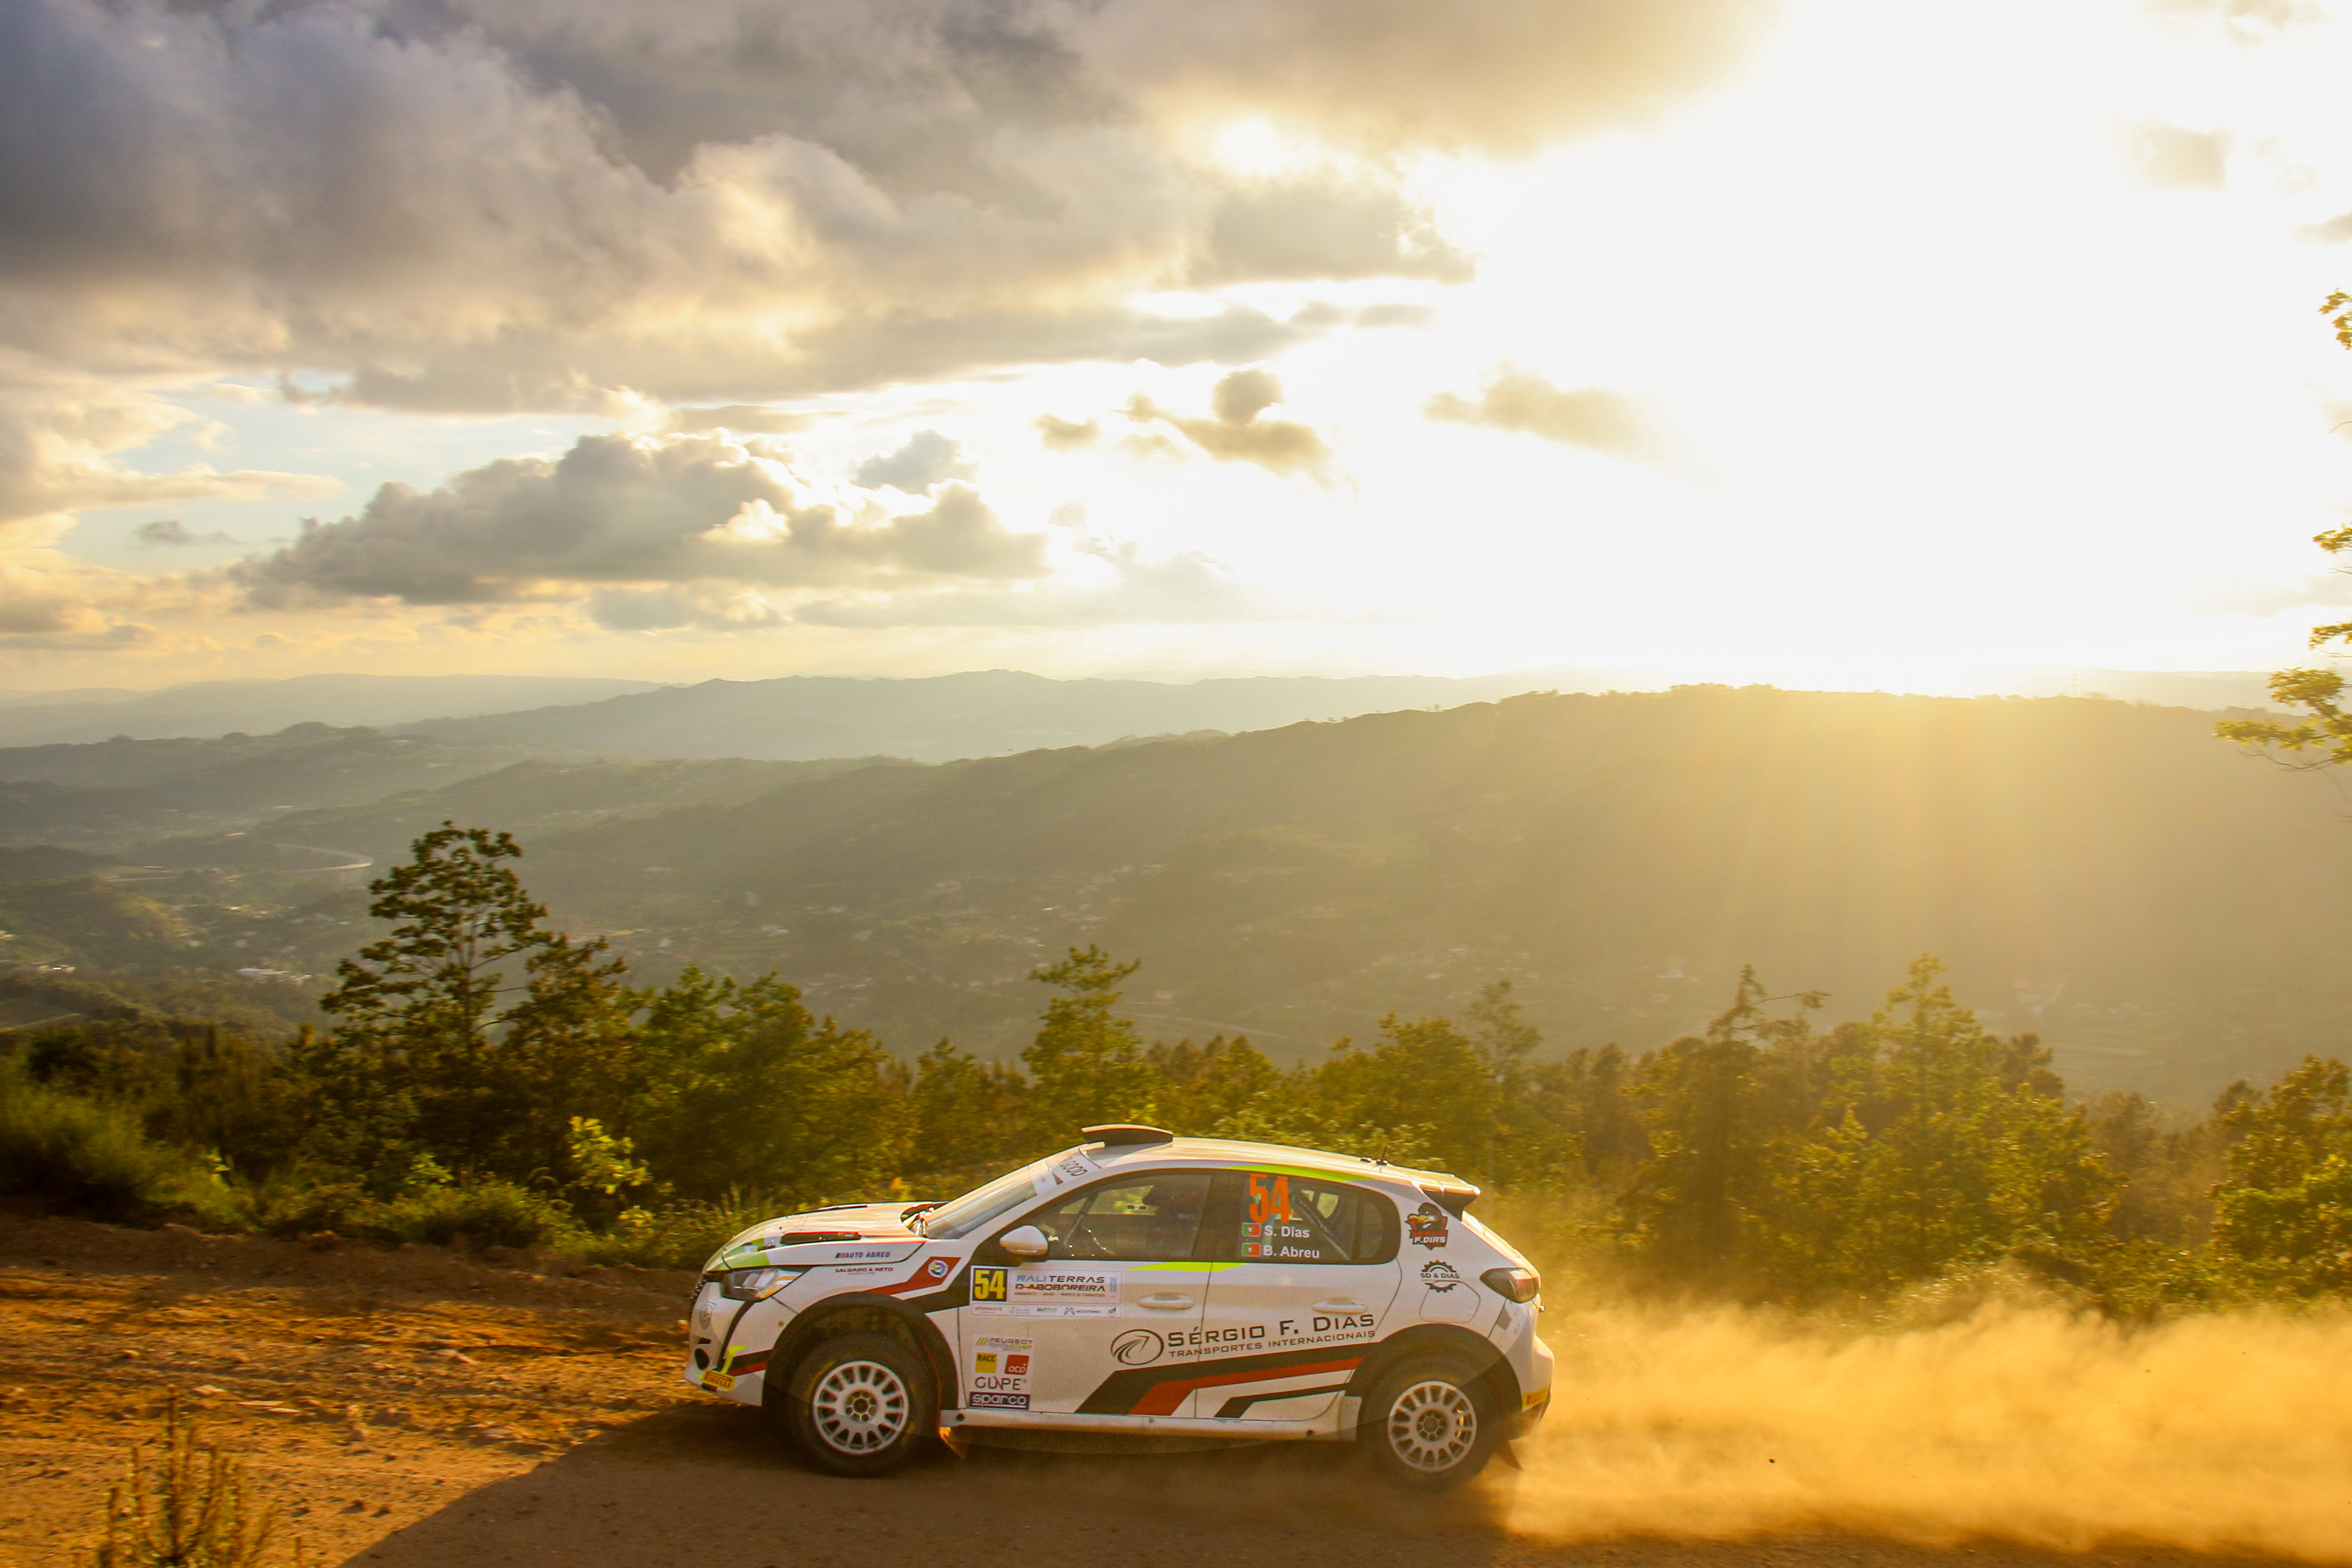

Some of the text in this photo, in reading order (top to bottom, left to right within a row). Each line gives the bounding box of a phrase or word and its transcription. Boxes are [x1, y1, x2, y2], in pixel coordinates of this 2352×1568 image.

[1250, 1174, 1292, 1223] 54
[1264, 1226, 1310, 1238] S. Dias
[1264, 1245, 1320, 1259] B. Abreu
[974, 1270, 1005, 1300] 54
[1168, 1325, 1265, 1348] SÉRGIO
[1280, 1320, 1299, 1335] F.
[1169, 1330, 1376, 1358] TRANSPORTES INTERNACIONAIS
[972, 1393, 1027, 1408] sparco
